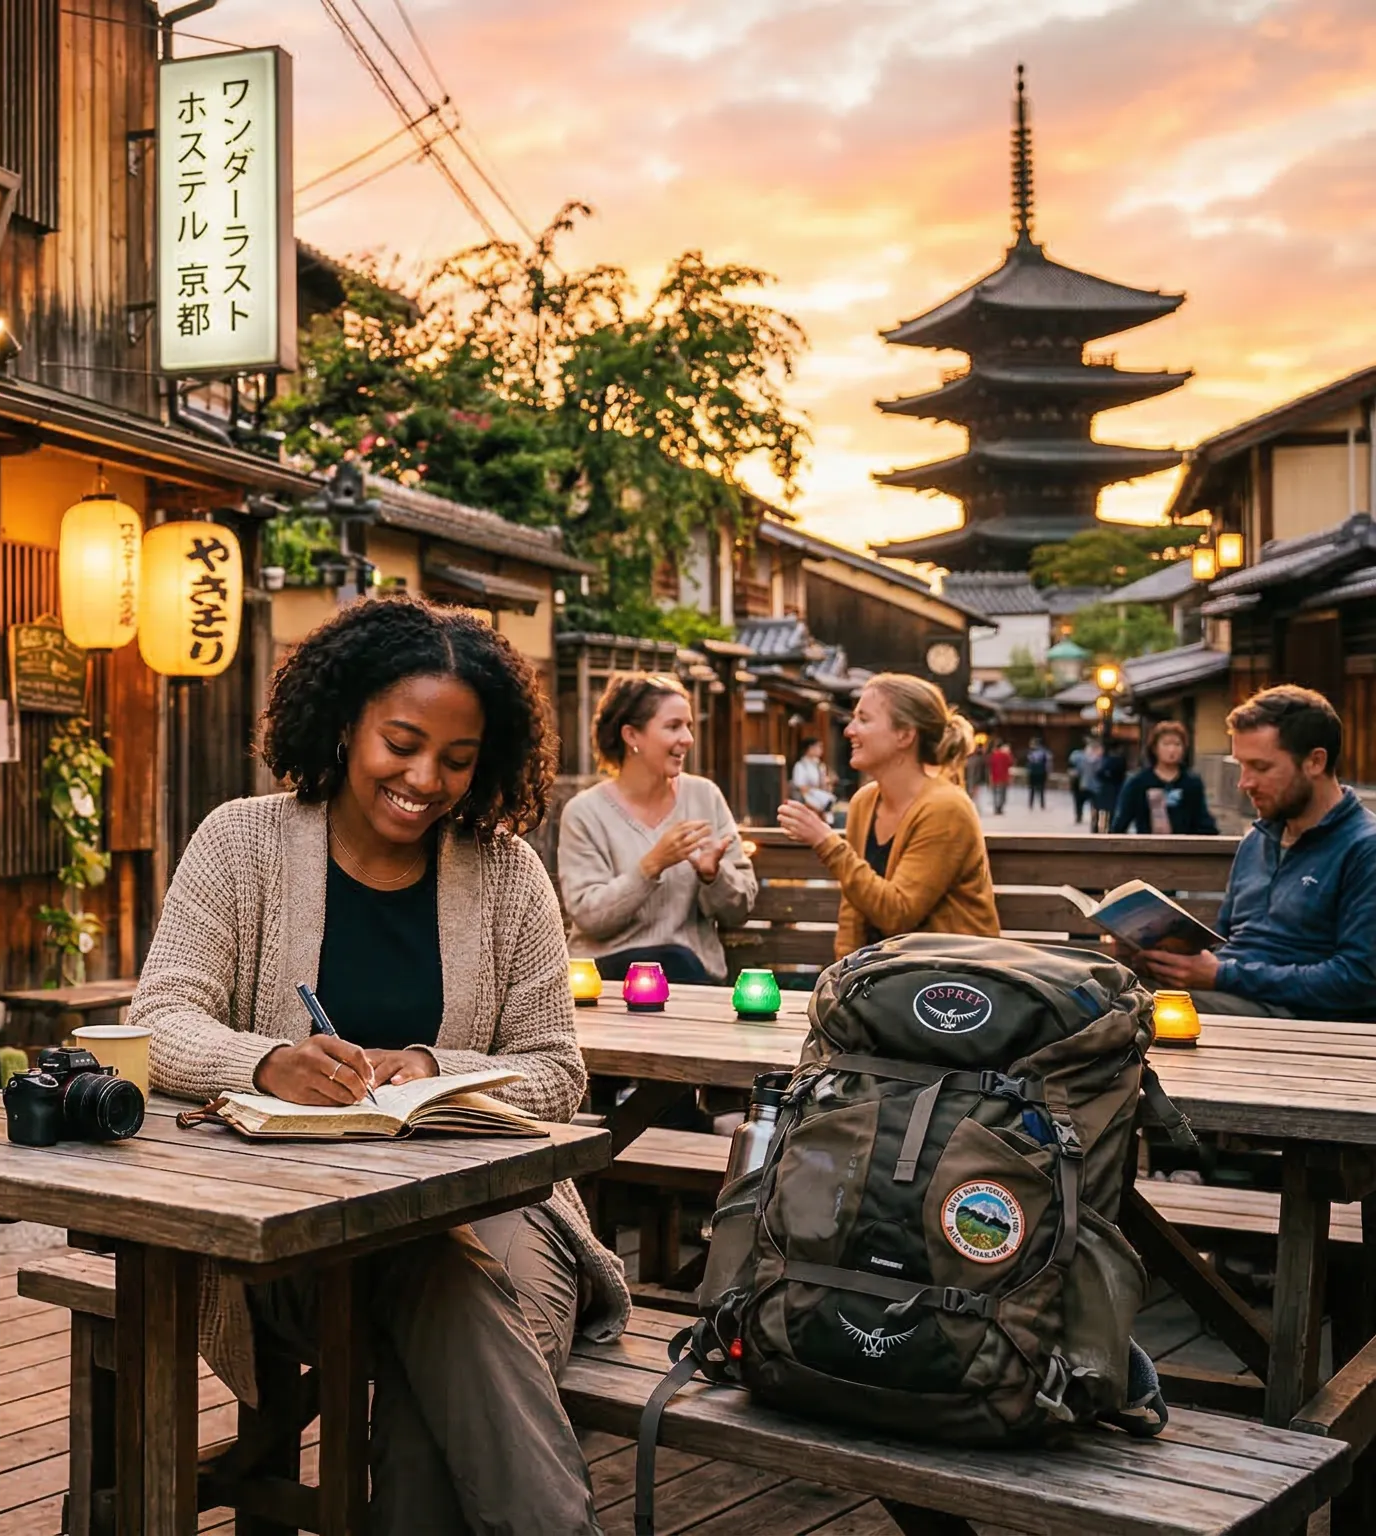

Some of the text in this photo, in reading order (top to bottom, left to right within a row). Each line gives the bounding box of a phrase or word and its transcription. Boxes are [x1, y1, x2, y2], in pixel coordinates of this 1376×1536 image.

[223, 79, 254, 331] ワンダーラスト
[925, 988, 984, 1006] OSPREY
